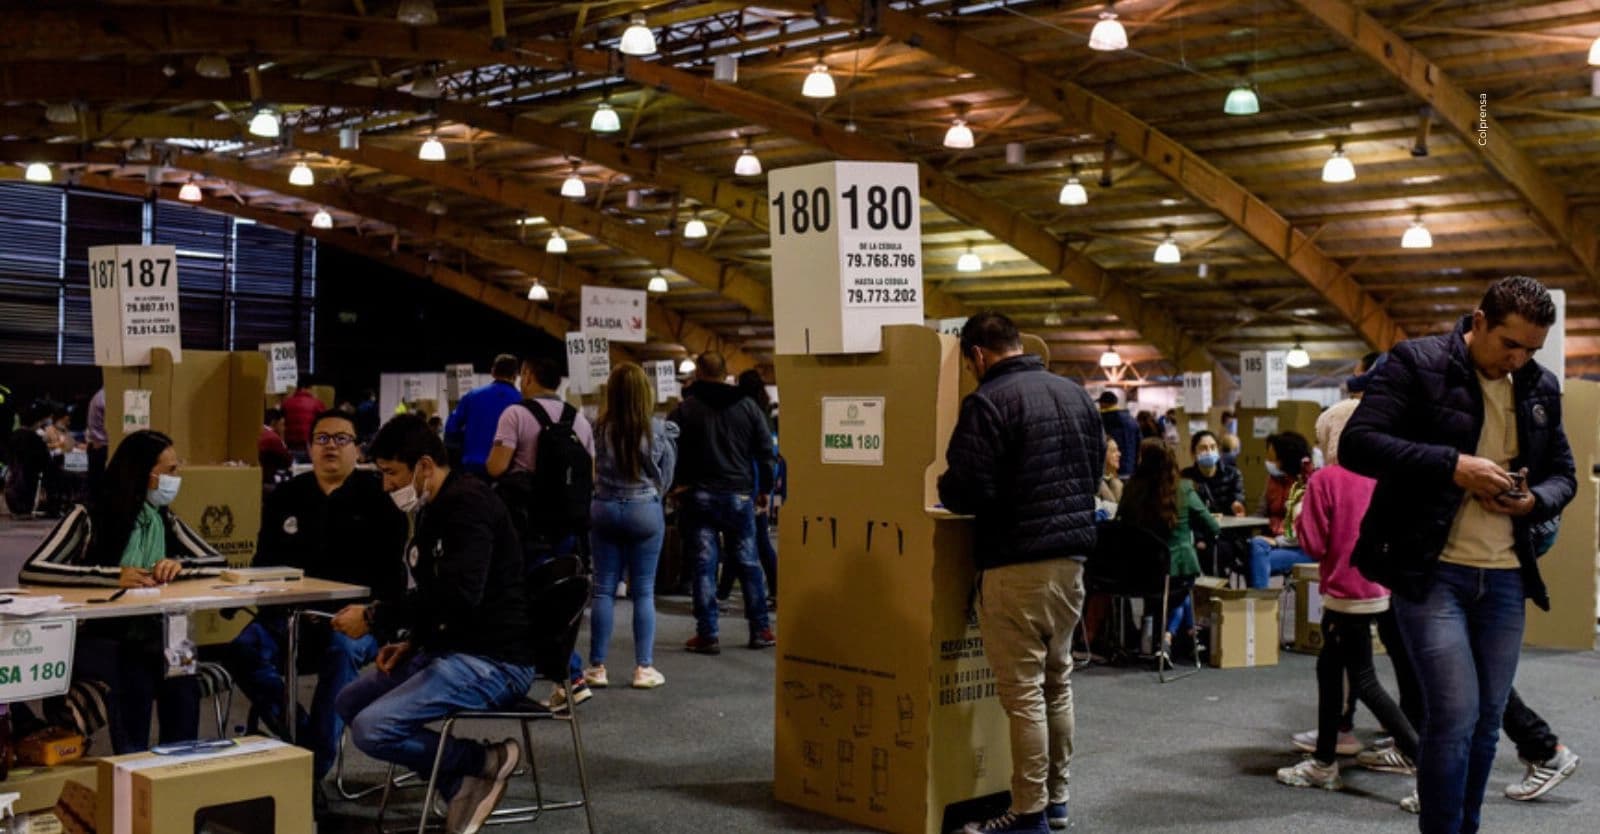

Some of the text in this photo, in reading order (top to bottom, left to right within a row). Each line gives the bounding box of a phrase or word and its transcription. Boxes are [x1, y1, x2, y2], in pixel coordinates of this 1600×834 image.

[771, 187, 830, 235] 180
[842, 184, 912, 230] 180
[869, 242, 877, 250] LA
[847, 253, 916, 267] 79.768.796
[91, 260, 115, 288] 187
[121, 258, 171, 287] 187
[848, 289, 917, 303] 79.773.202
[586, 316, 622, 329] SALIDA
[568, 339, 586, 355] 193
[588, 337, 608, 353] 193
[1245, 358, 1262, 371] 185
[825, 434, 880, 449] MESA 180
[30, 661, 66, 681] 180
